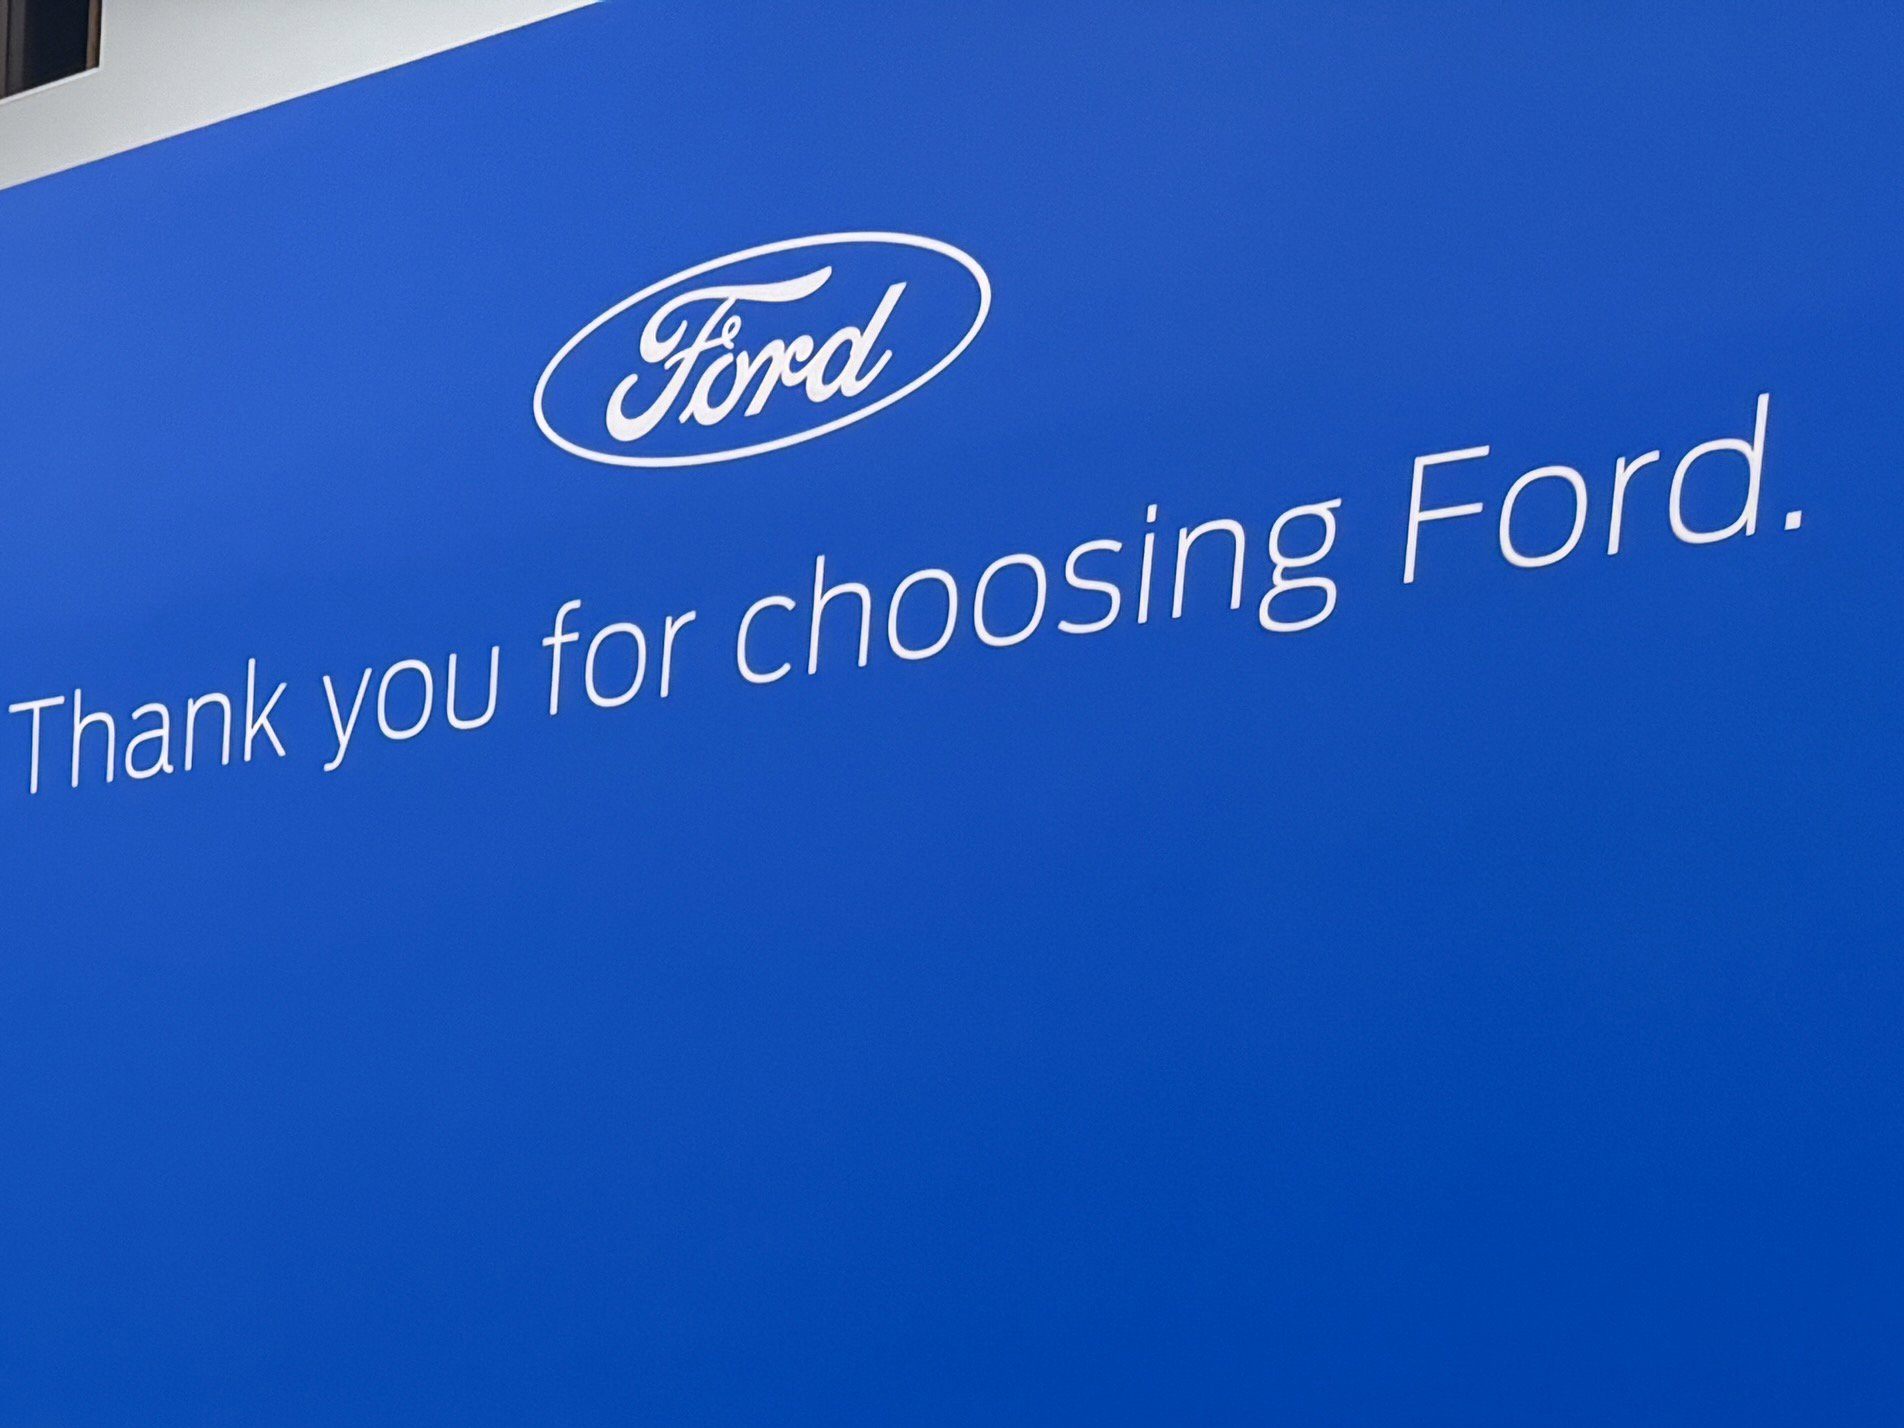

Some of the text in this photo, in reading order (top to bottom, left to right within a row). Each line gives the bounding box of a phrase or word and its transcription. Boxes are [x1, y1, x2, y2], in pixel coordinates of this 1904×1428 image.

[605, 265, 908, 443] Ford
[8, 392, 1803, 795] Thank you for choosing Ford.
